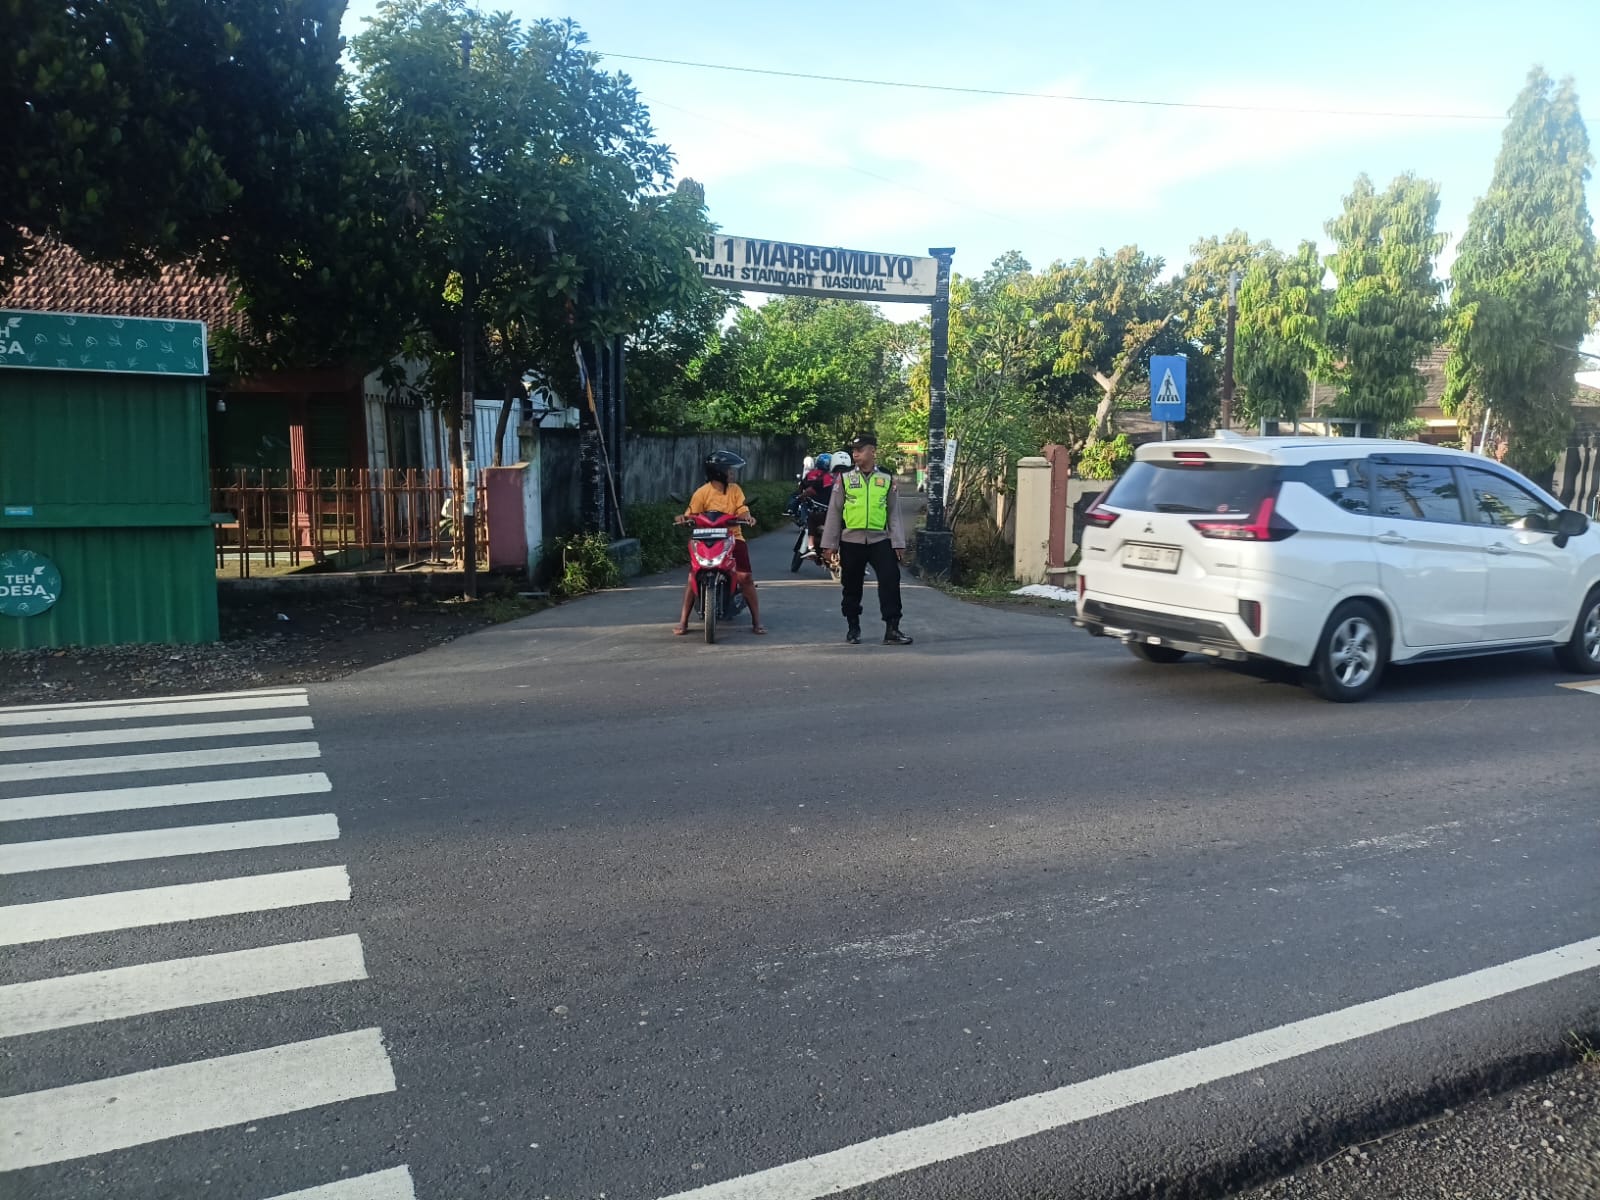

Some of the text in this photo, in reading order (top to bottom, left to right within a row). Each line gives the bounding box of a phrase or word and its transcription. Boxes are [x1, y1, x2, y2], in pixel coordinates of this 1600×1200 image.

[723, 238, 734, 263] 1
[745, 240, 913, 281] MARGOMULYO
[741, 267, 814, 287] STANDART
[822, 275, 887, 291] NASIONAL
[4, 574, 36, 584] TEH
[0, 584, 47, 596] DESA
